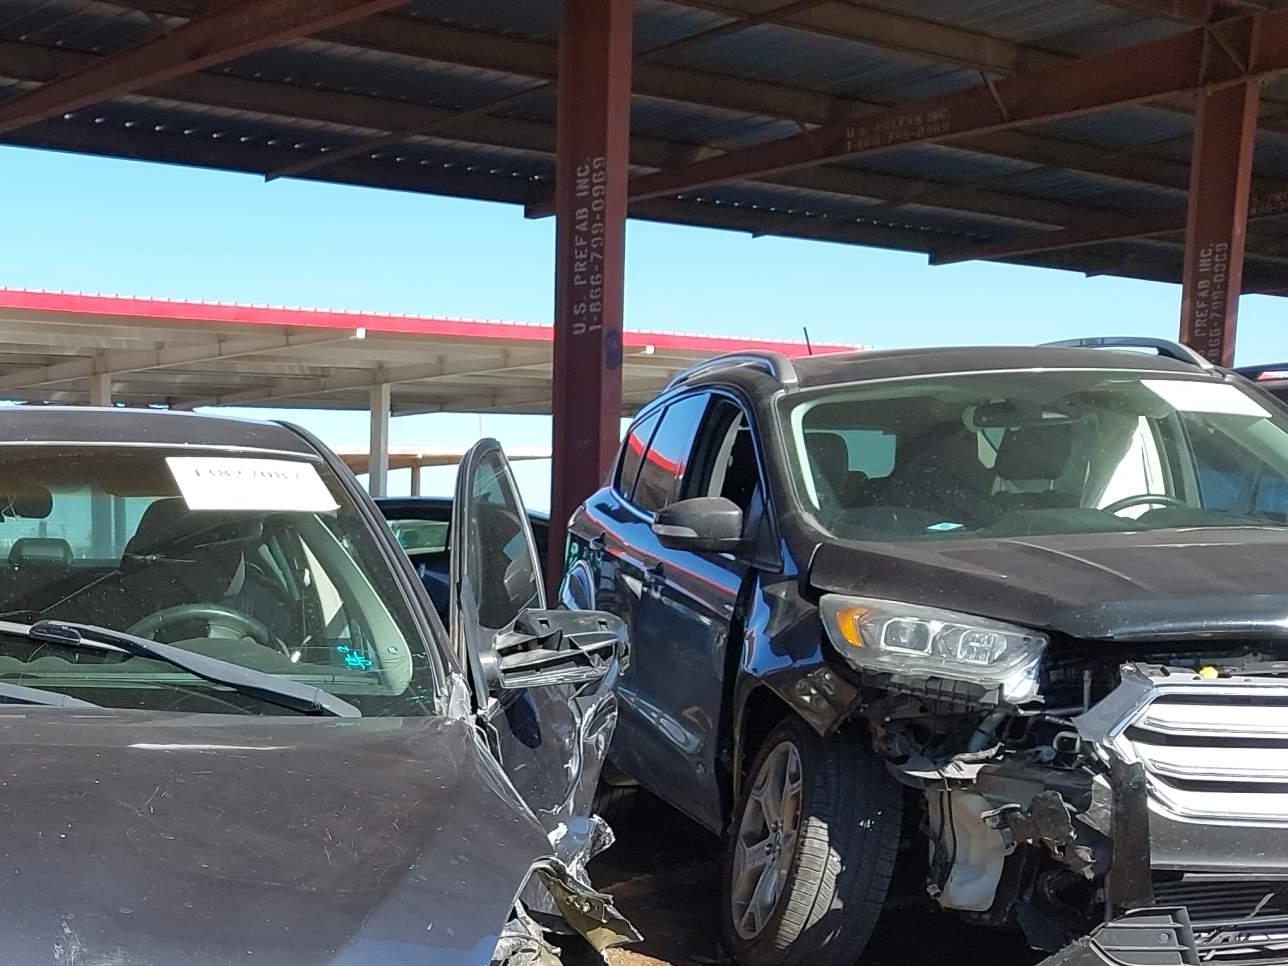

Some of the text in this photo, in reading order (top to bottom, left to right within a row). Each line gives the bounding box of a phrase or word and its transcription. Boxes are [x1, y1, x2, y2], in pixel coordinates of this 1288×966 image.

[572, 156, 591, 336] U.S. PREFAB INC.
